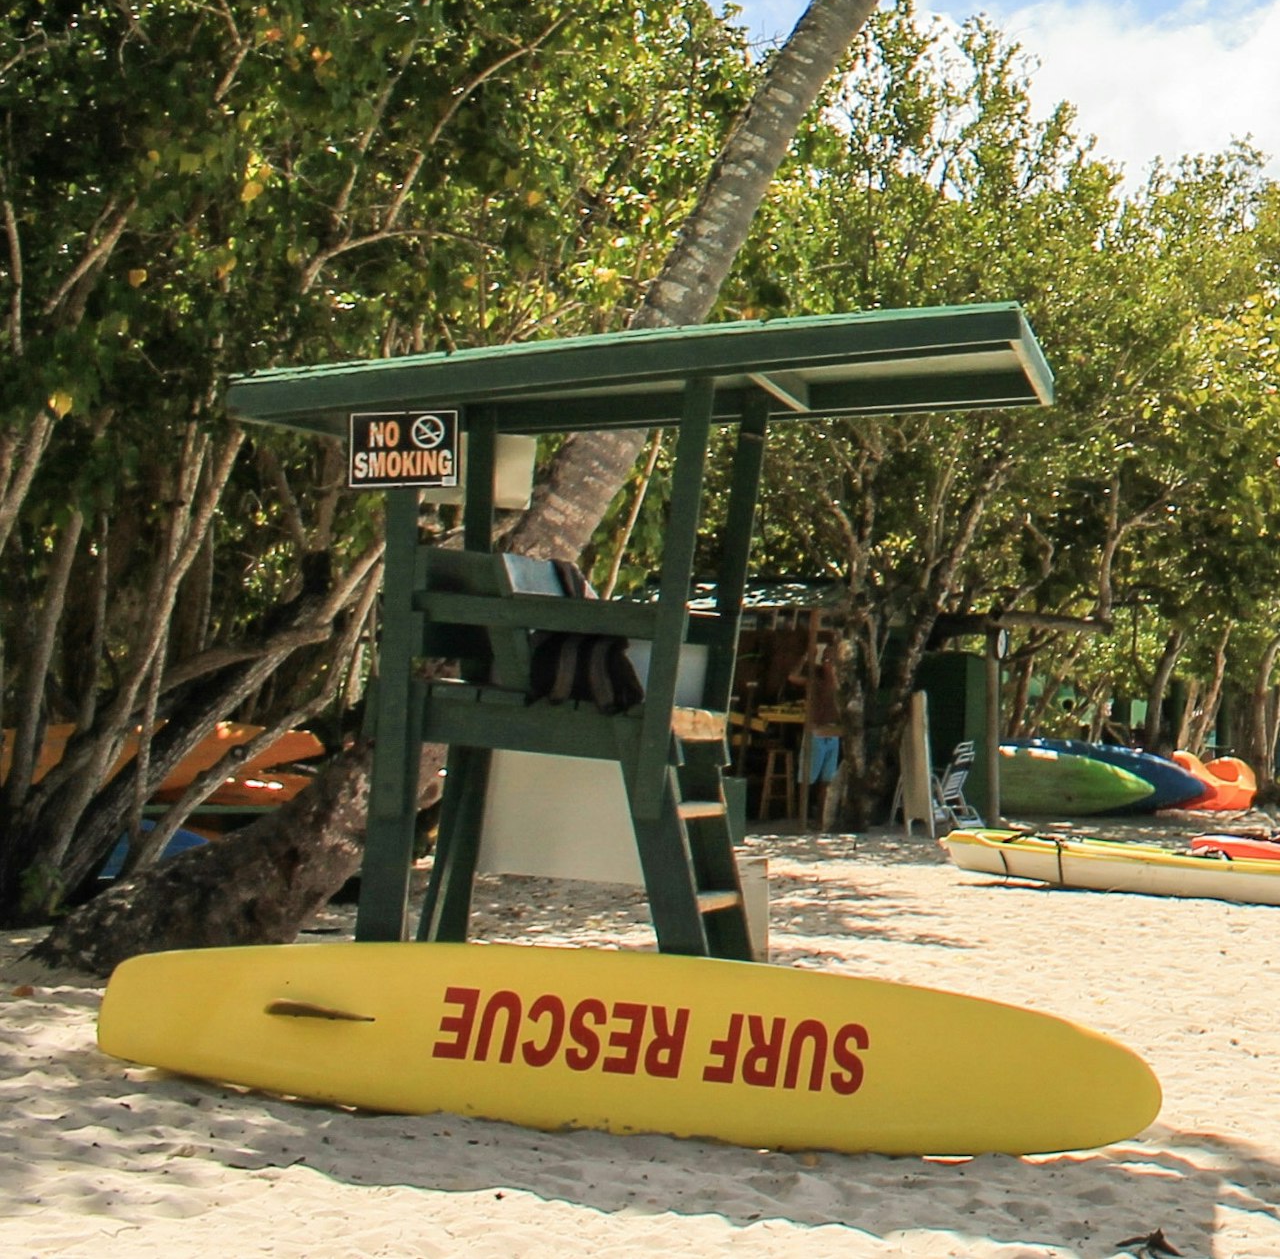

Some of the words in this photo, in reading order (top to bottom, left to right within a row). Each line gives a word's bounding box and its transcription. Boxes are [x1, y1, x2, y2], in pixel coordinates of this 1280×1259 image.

[368, 420, 400, 449] NO
[353, 448, 453, 479] SMOKING
[432, 986, 691, 1078] RESCUE
[703, 1013, 870, 1095] SURF
